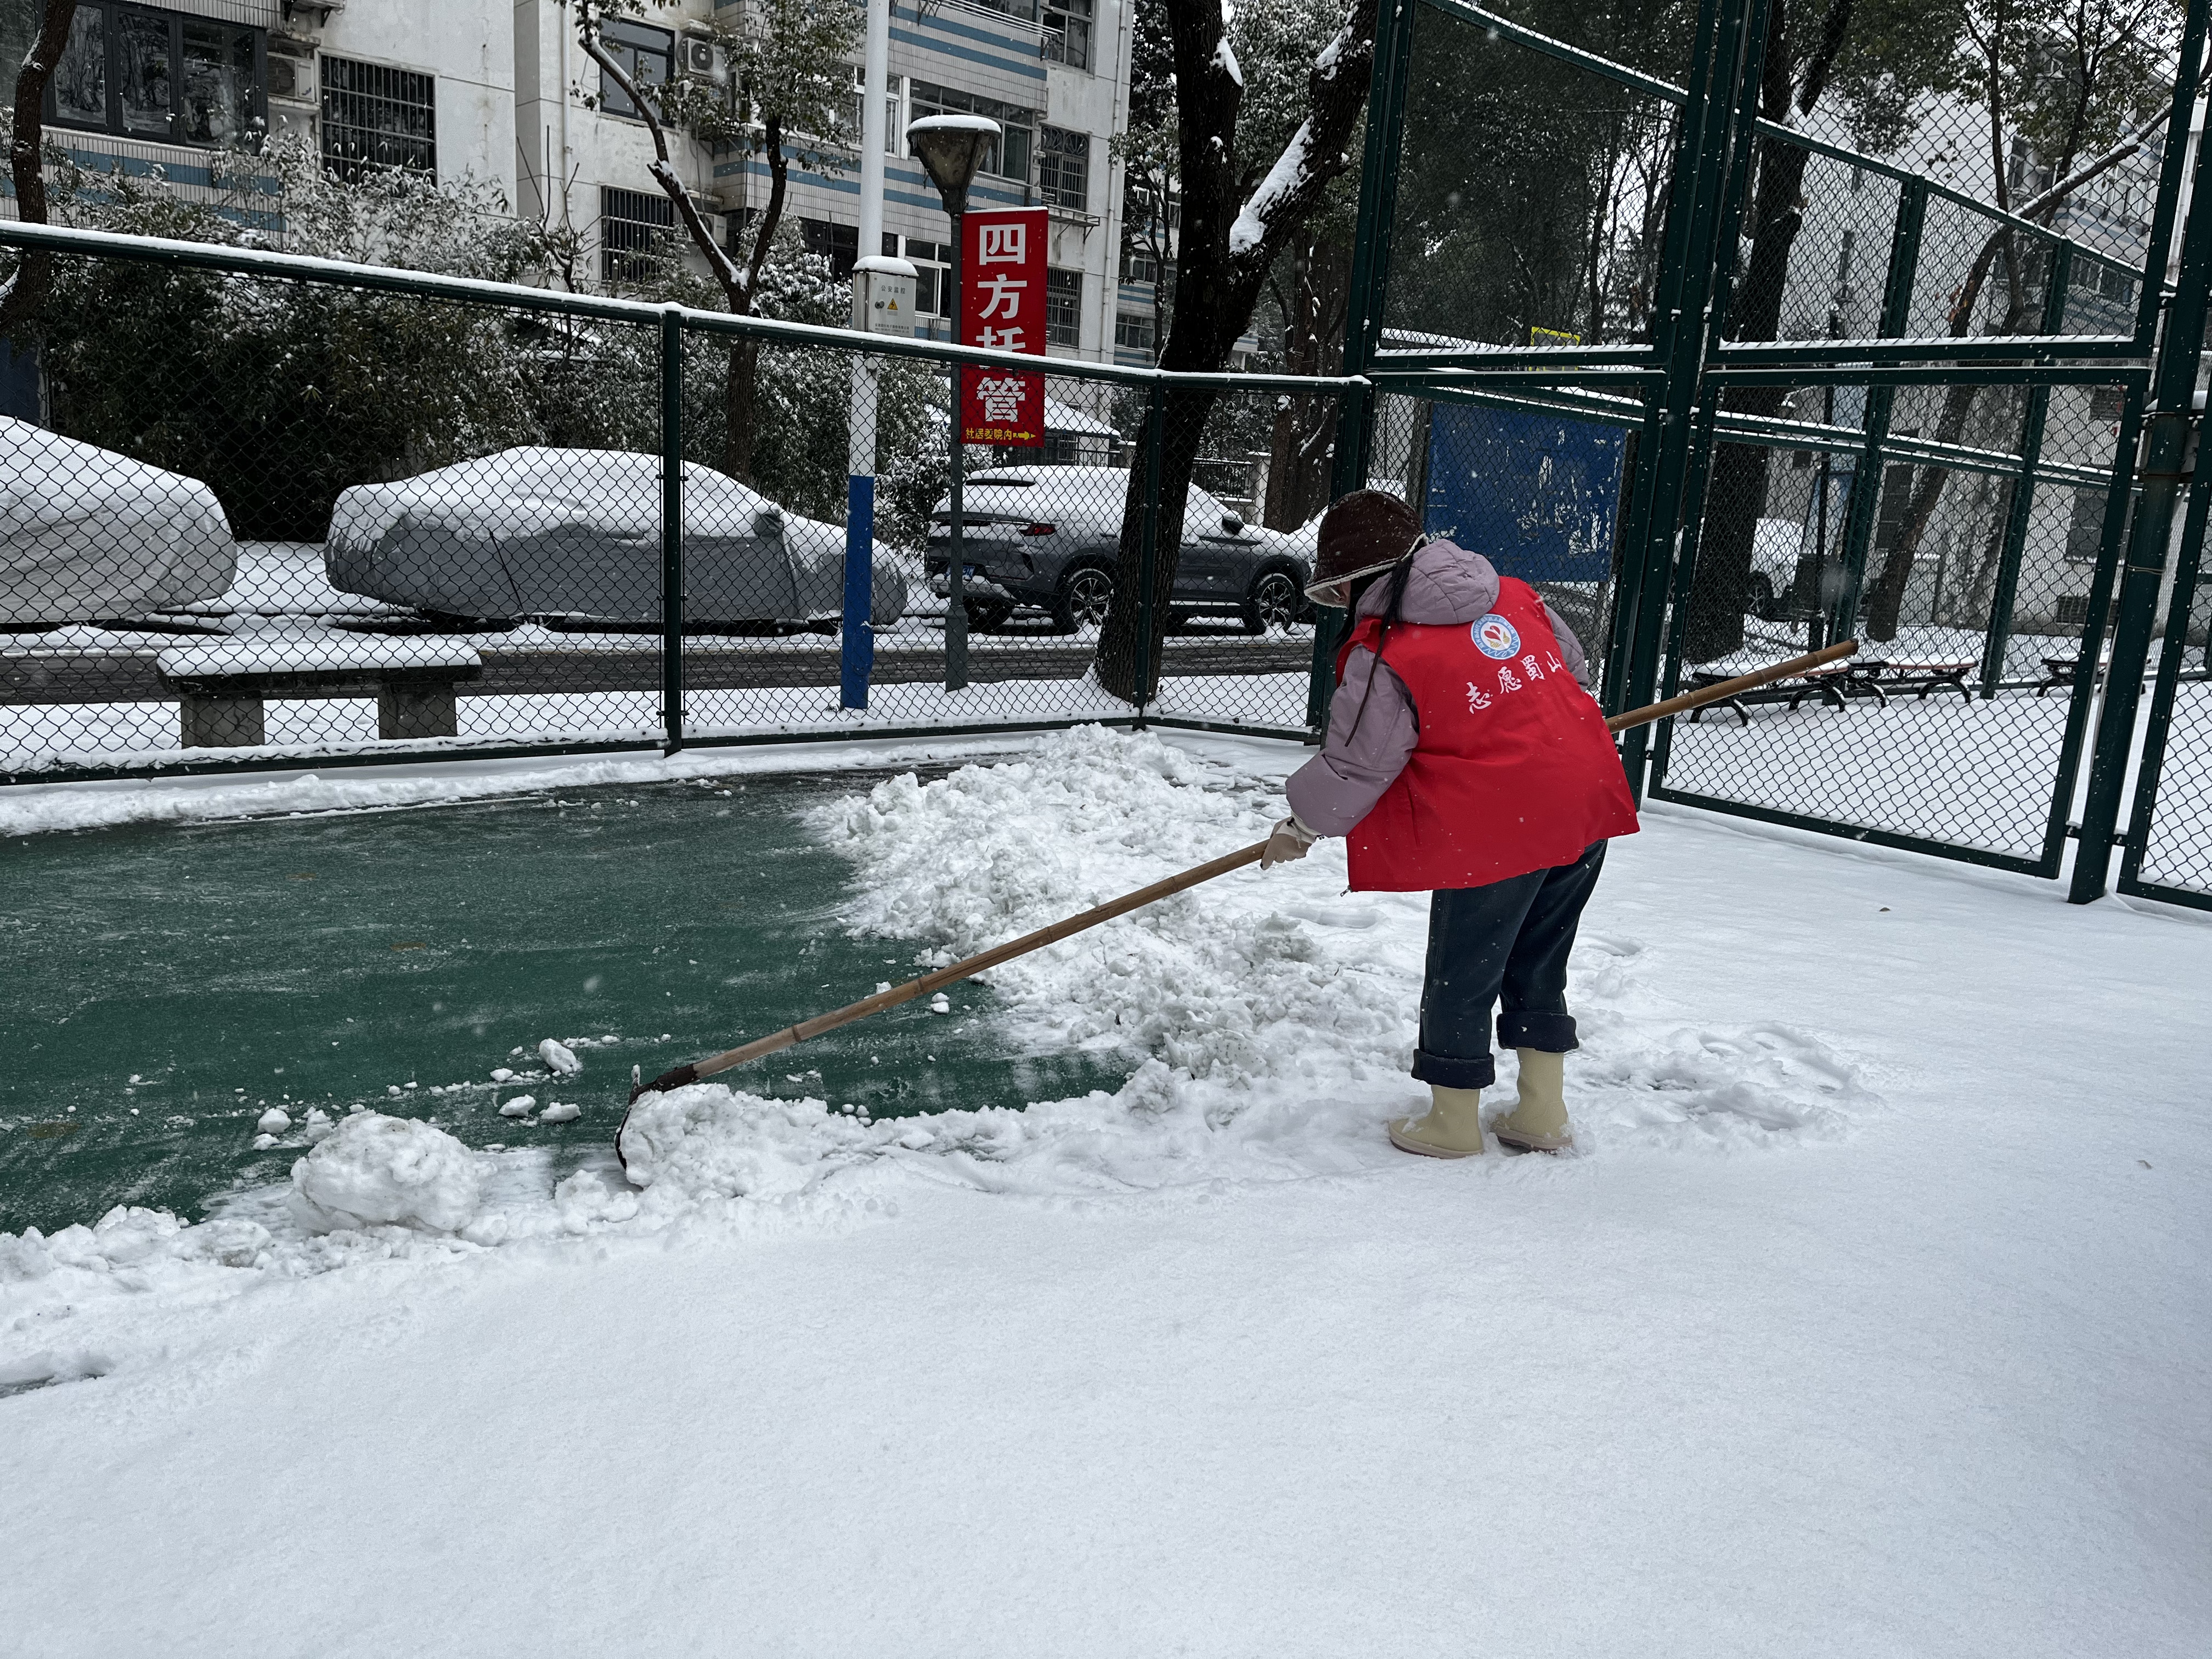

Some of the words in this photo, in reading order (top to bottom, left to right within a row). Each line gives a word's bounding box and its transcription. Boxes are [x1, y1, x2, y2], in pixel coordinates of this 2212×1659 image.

[881, 285, 906, 294] 公安监控
[976, 223, 1028, 422] 四方托管
[1465, 651, 1564, 714] 志愿蜀山
